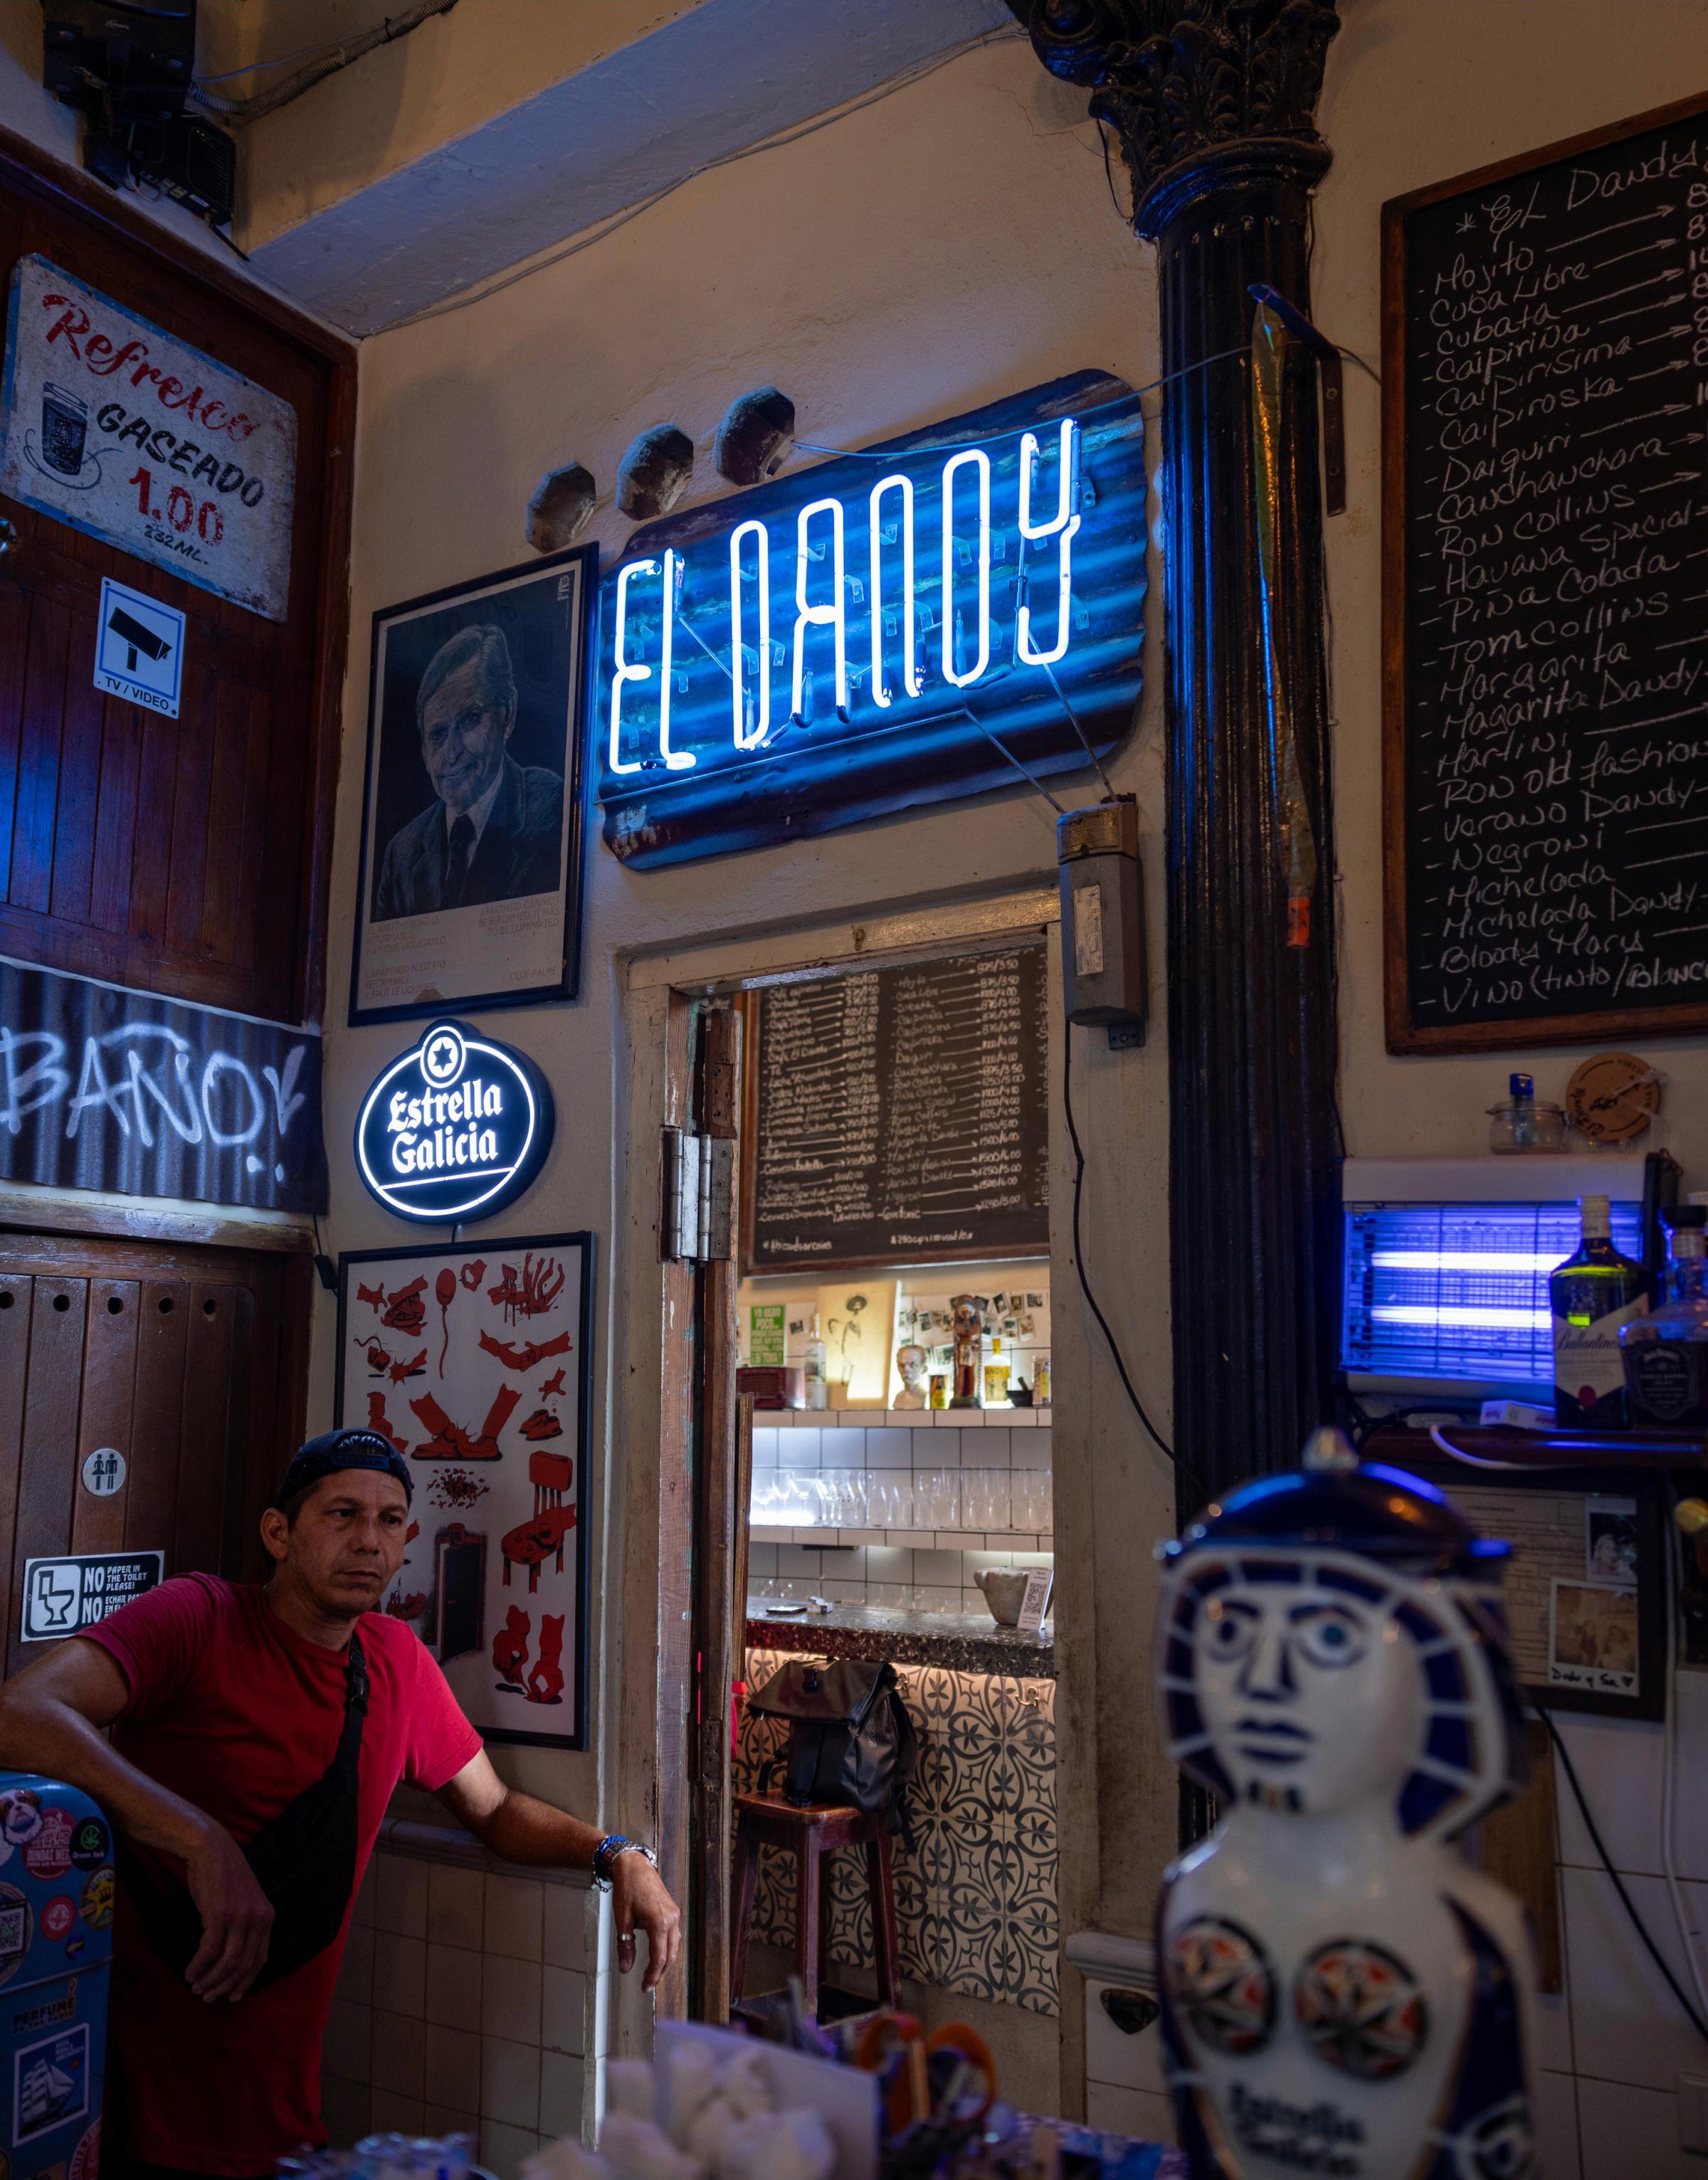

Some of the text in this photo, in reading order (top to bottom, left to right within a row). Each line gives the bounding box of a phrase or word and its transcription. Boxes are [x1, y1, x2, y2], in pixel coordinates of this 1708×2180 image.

[1567, 139, 1697, 211] Dandy
[1435, 241, 1534, 295] Mojito
[1430, 291, 1508, 326] Cuba
[1514, 263, 1590, 302] Libre
[1437, 302, 1561, 354] Cubata
[42, 294, 261, 443] Refresco
[1440, 377, 1623, 448] Caipiroska
[97, 403, 265, 508] GASEADO
[1436, 437, 1672, 523] Canchanchara
[129, 467, 225, 547] 1.00
[1435, 484, 1635, 560] Ron Collins
[610, 418, 1081, 773] EL DANDY
[1439, 546, 1681, 633] Piña Colada
[1447, 546, 1573, 595] Havana
[1439, 591, 1668, 670] Tom Collins
[105, 677, 123, 694] TV
[130, 686, 169, 711] VIDEO
[1440, 632, 1633, 705] Margarita
[1599, 658, 1704, 711] Dandy
[1438, 729, 1567, 778] Martini
[1437, 776, 1515, 809] Ron
[1580, 777, 1697, 822] Dandy
[1452, 821, 1604, 873] Negroni
[480, 896, 559, 915] APARTHEID CANNOT
[1447, 859, 1618, 907] Michelada
[485, 917, 559, 936] TO BE ELIMINATED
[543, 905, 559, 916] HAS
[1443, 880, 1698, 939] Michelada Dandy
[532, 966, 557, 978] PALME
[1440, 937, 1539, 974] Bloody
[387, 1079, 502, 1132] Estrella
[391, 1122, 497, 1174] Galicia
[83, 1566, 105, 1594] NO
[107, 1565, 131, 1574] PAPER
[106, 1581, 135, 1591] PLEASE!
[122, 1572, 147, 1581] TOILET
[82, 1595, 127, 1624] NO ECHAR
[14, 1997, 75, 2027] PERFUME
